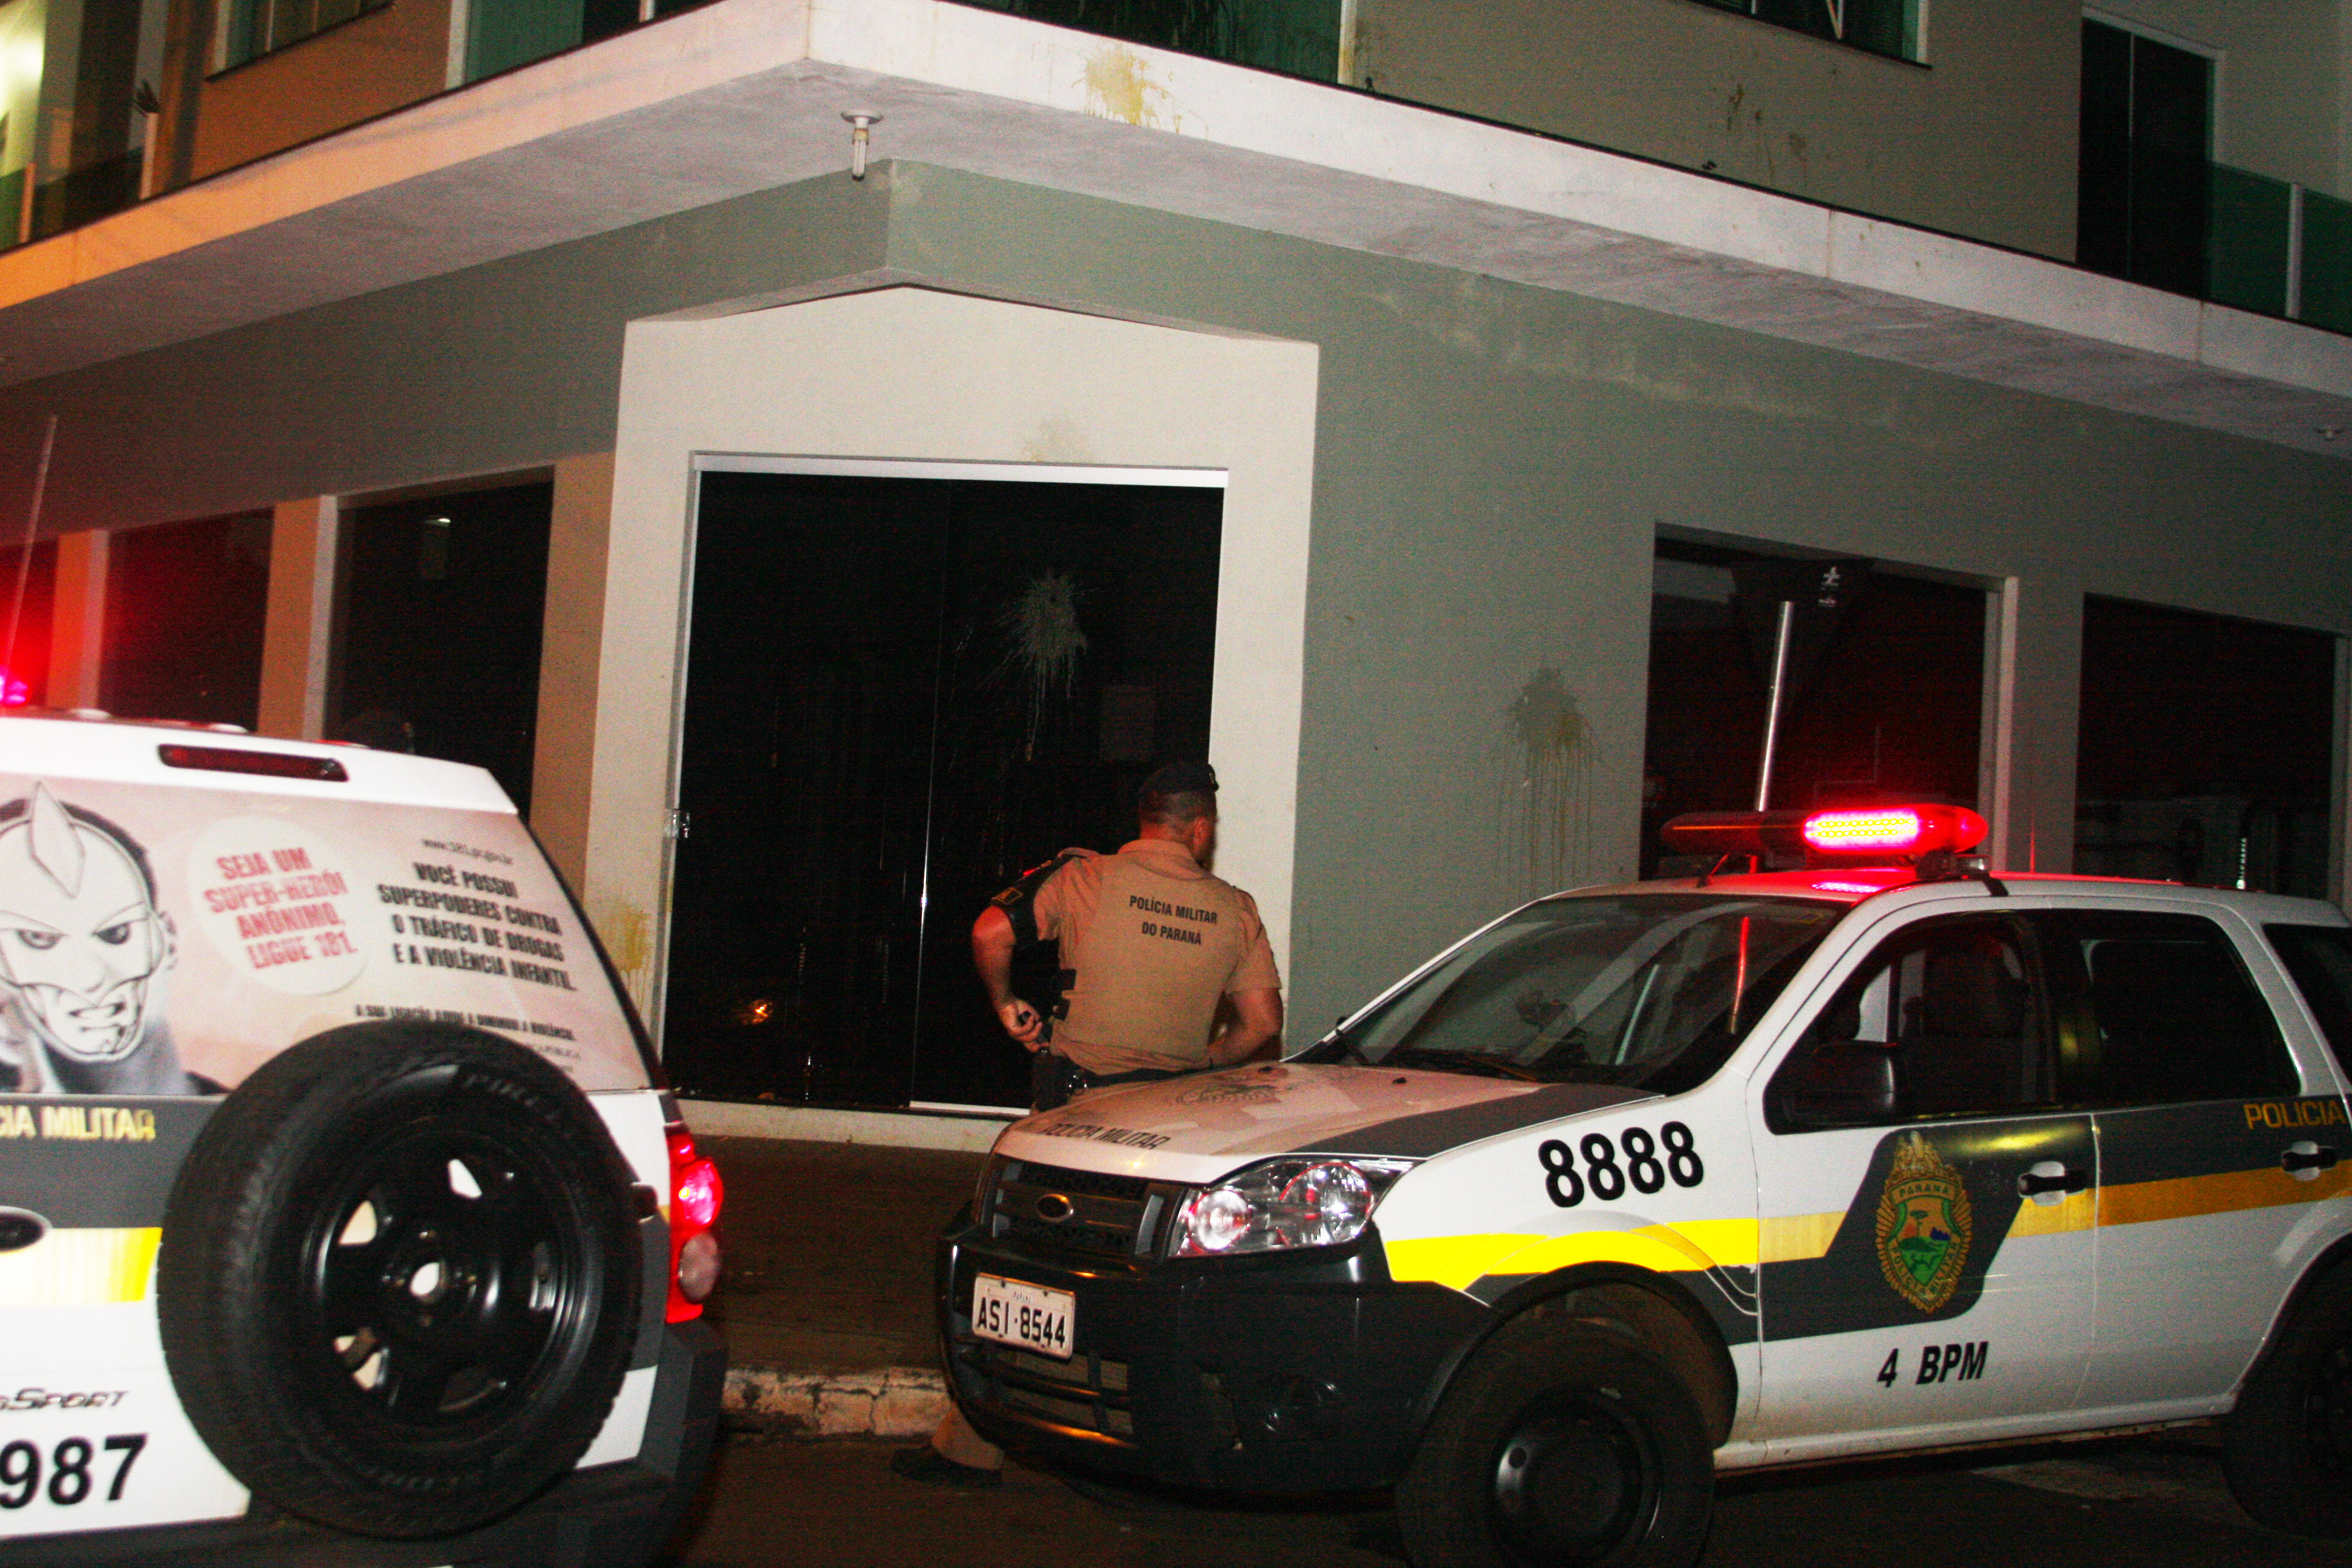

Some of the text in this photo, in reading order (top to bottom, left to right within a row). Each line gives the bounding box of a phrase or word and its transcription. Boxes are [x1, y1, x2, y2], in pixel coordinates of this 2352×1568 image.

[216, 846, 312, 880] SEJA UM
[413, 861, 519, 898] VOCÊ POSSUI
[377, 883, 563, 936] SUPERPODERES CONTRA
[1129, 895, 1218, 924] POLÍCIA MILITAR
[391, 913, 565, 962] O TRÁFICO DE DROGAS
[1142, 921, 1201, 945] DO PARANÁ
[246, 935, 312, 969] LIGUE
[393, 942, 405, 963] E
[409, 944, 422, 964] A
[424, 945, 509, 976] VIOLÊNCIA
[41, 1105, 157, 1141] MILITAR
[2243, 1100, 2347, 1129] POLICIA
[1094, 1128, 1171, 1151] MILITAR
[1538, 1121, 1704, 1208] 8888
[1877, 1341, 1988, 1387] 4 BPM
[0, 1433, 148, 1509] 987
